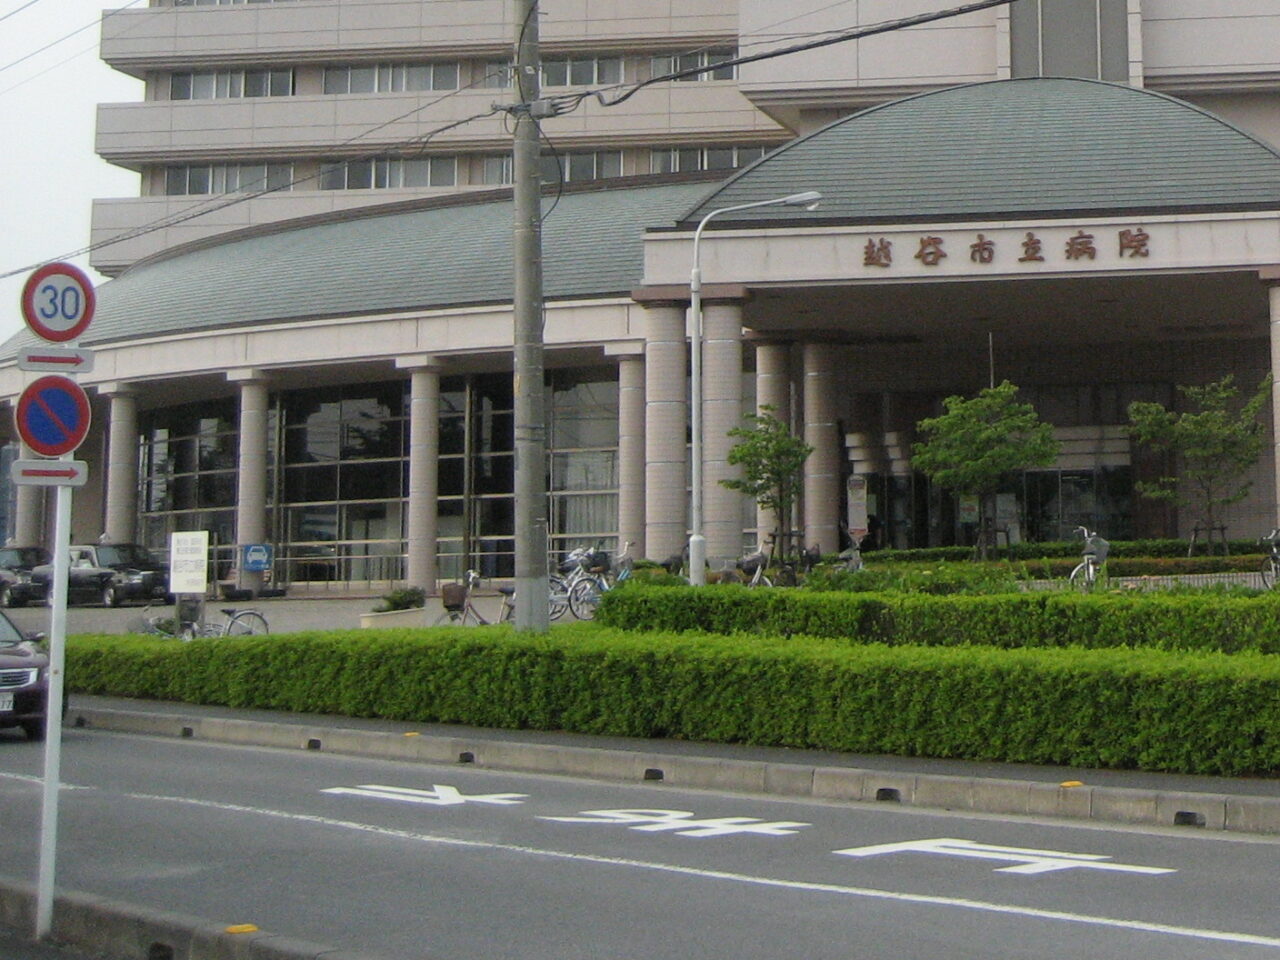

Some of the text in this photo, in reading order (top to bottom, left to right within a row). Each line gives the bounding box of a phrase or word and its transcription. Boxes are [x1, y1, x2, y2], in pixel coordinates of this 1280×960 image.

[862, 227, 1151, 268] 越谷市立病院
[40, 285, 81, 320] 30
